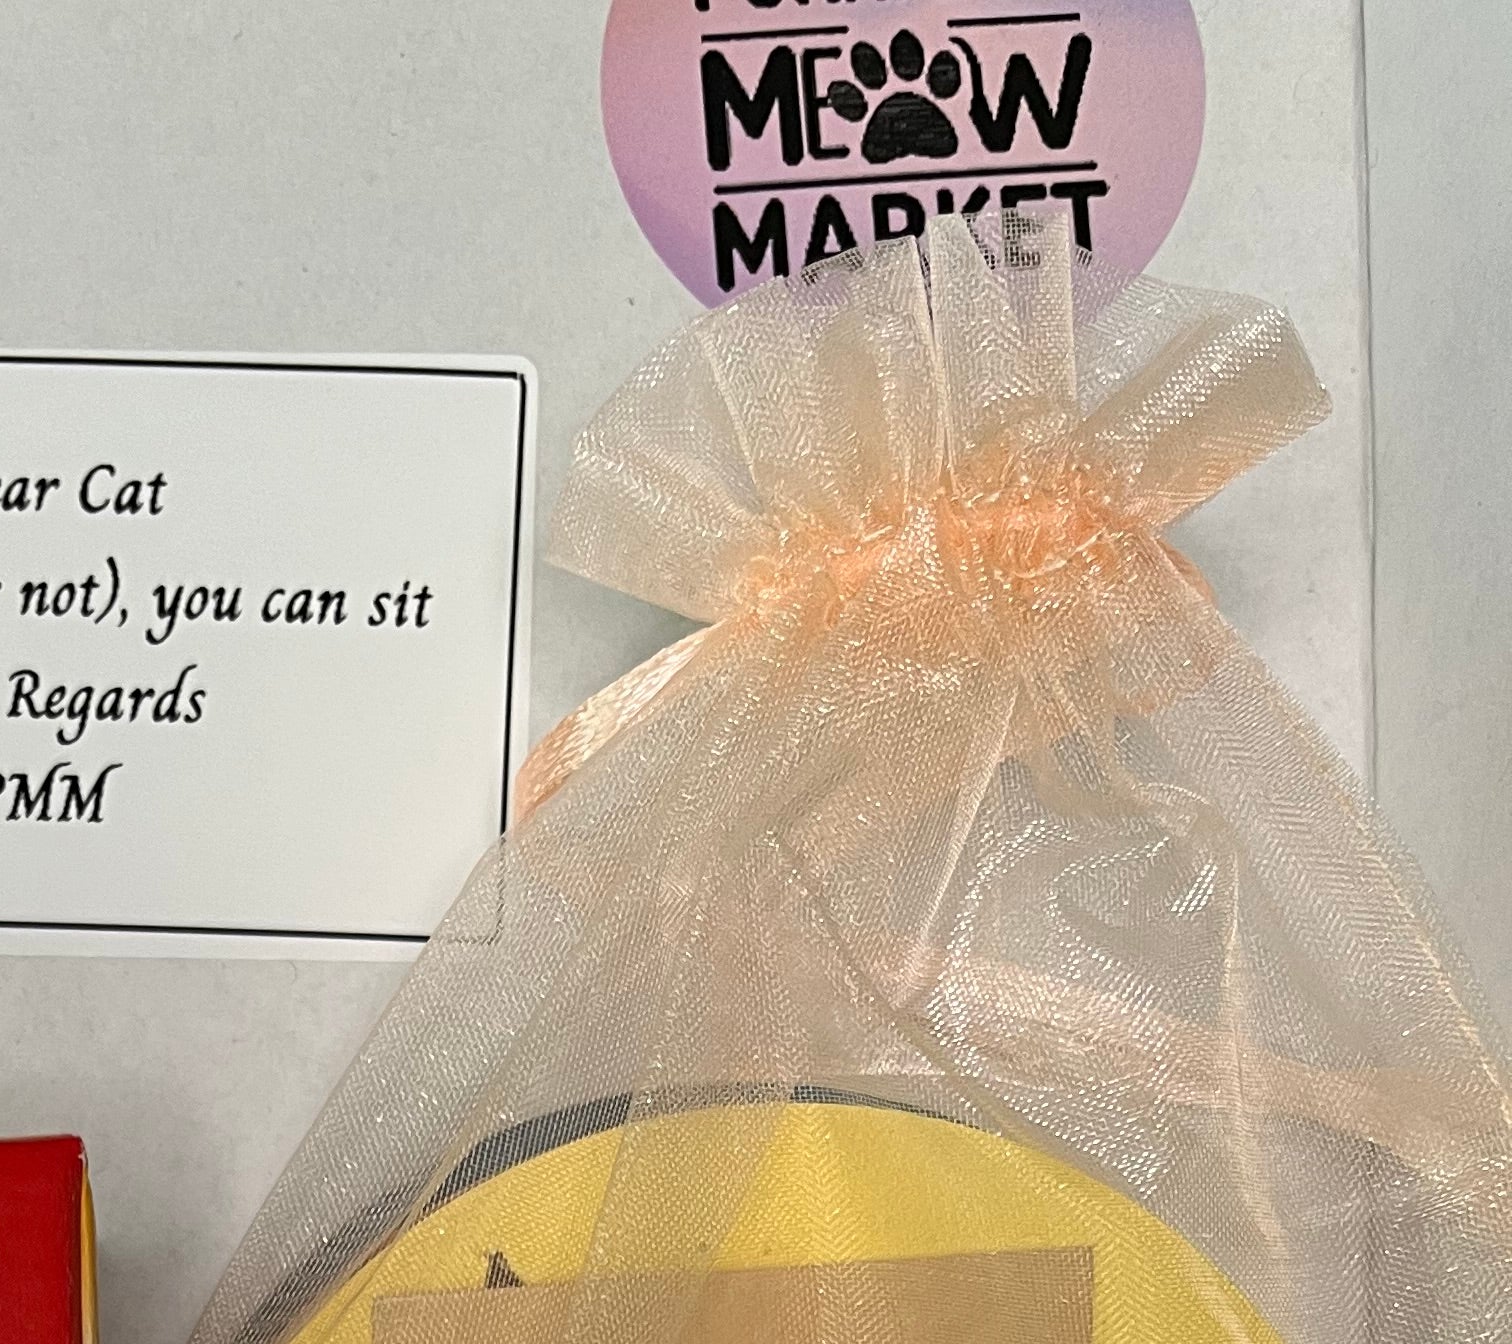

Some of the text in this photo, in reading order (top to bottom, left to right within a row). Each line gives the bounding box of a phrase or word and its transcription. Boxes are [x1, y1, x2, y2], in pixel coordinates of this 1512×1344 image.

[76, 463, 168, 517] Cat
[20, 556, 130, 629] not),
[147, 586, 242, 644] you
[262, 584, 349, 627] can
[367, 579, 432, 629] sit
[6, 664, 207, 746] Regards
